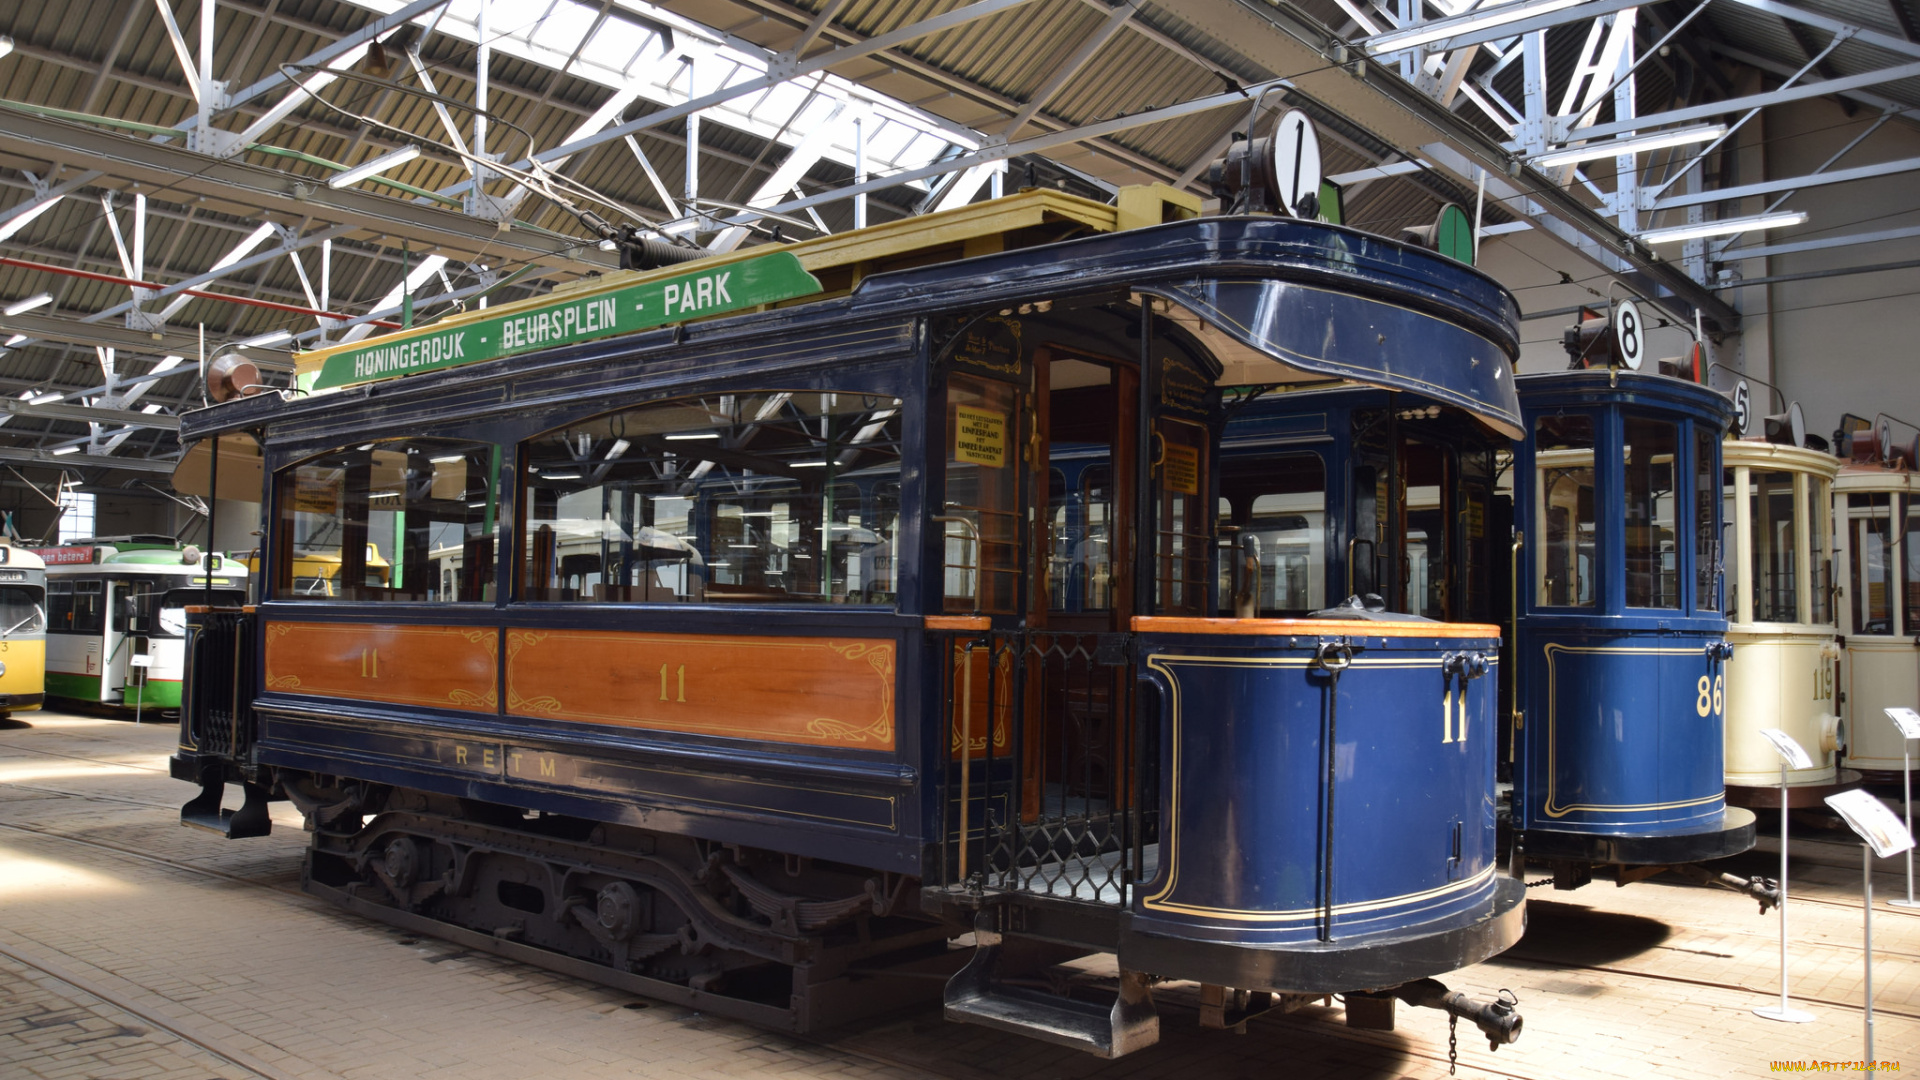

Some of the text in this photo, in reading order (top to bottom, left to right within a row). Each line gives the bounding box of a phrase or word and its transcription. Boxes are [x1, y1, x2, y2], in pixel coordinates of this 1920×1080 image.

[1290, 119, 1304, 210] 1
[354, 331, 465, 378] HONINGERDIJK
[503, 298, 616, 350] BEURSPLEIN
[664, 271, 732, 316] PARK
[1621, 311, 1638, 358] 8
[1738, 386, 1748, 432] 5
[58, 549, 90, 562] betere!
[361, 648, 378, 678] 11
[658, 663, 687, 703] 11
[1813, 668, 1832, 701] 119
[1442, 689, 1467, 744] 11
[1696, 675, 1723, 718] 86
